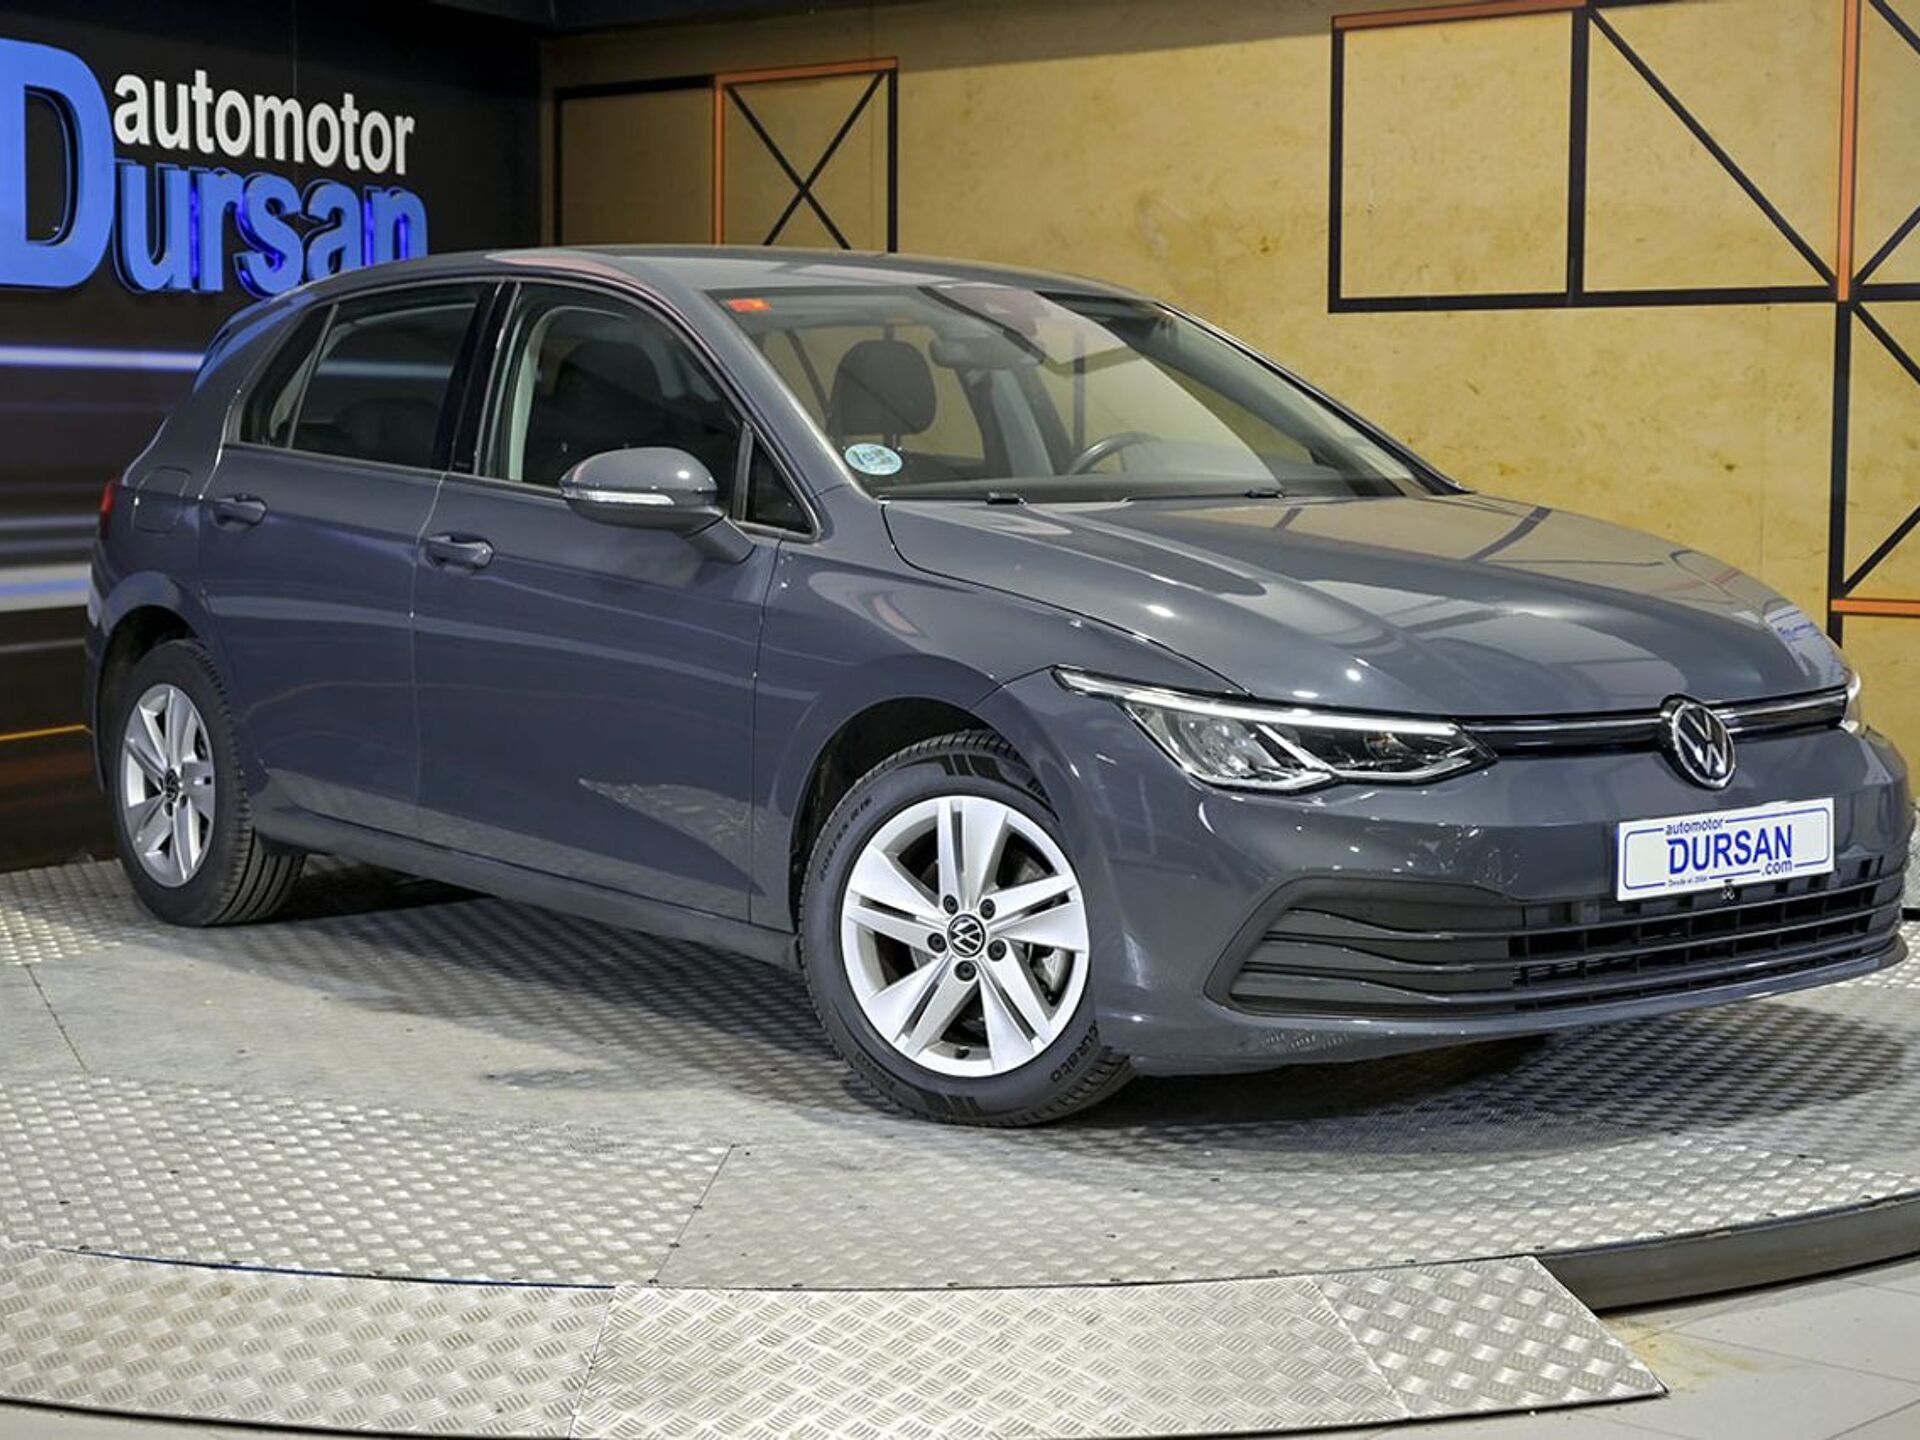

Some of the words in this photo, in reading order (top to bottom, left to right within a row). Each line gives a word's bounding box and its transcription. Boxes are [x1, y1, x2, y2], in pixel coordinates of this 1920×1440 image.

[113, 69, 415, 175] automotor
[0, 38, 428, 298] Dursan
[1665, 817, 1724, 835] automotor
[1666, 824, 1793, 875] DURSAN
[1760, 859, 1793, 877] .com
